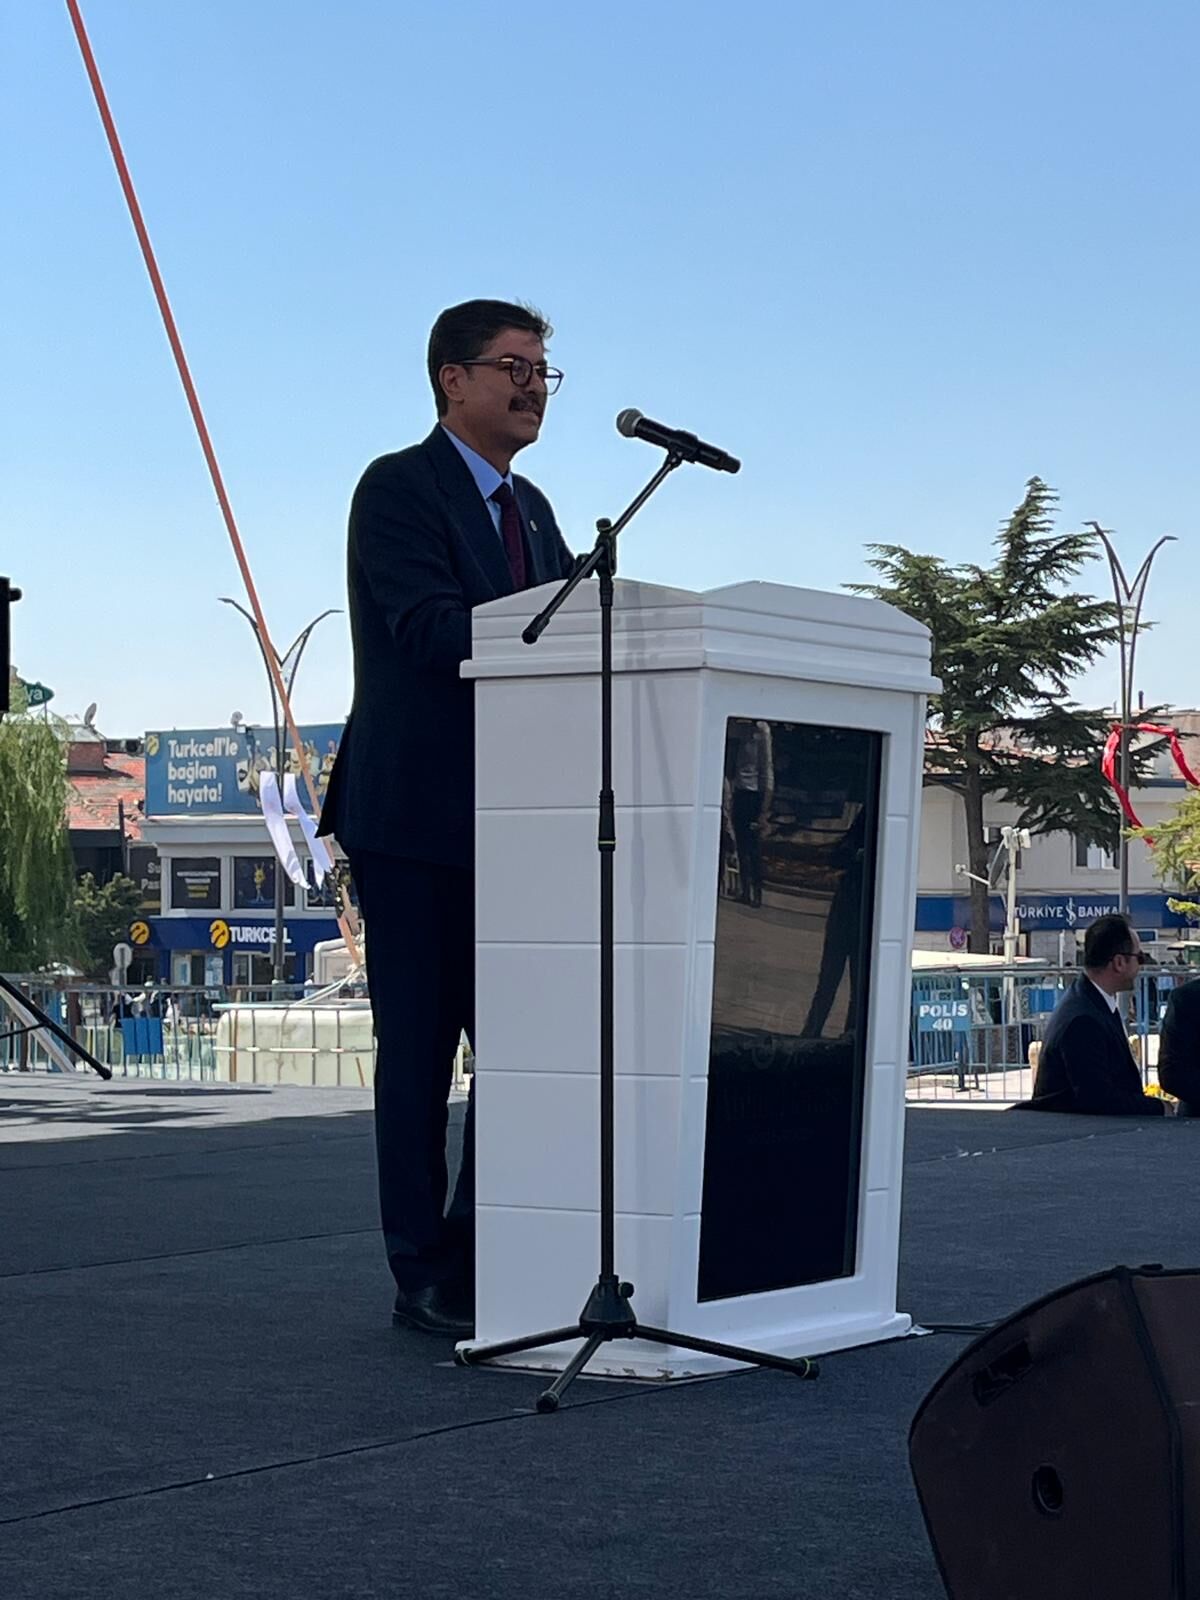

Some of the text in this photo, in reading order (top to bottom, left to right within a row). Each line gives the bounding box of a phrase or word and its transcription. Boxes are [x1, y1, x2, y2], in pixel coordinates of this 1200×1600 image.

[167, 736, 238, 759] Turkcell'le
[167, 760, 217, 785] bağlan
[167, 782, 223, 808] hayata!
[228, 926, 292, 944] TURKCEL
[919, 1001, 968, 1018] POLİS
[932, 1018, 953, 1031] 40
